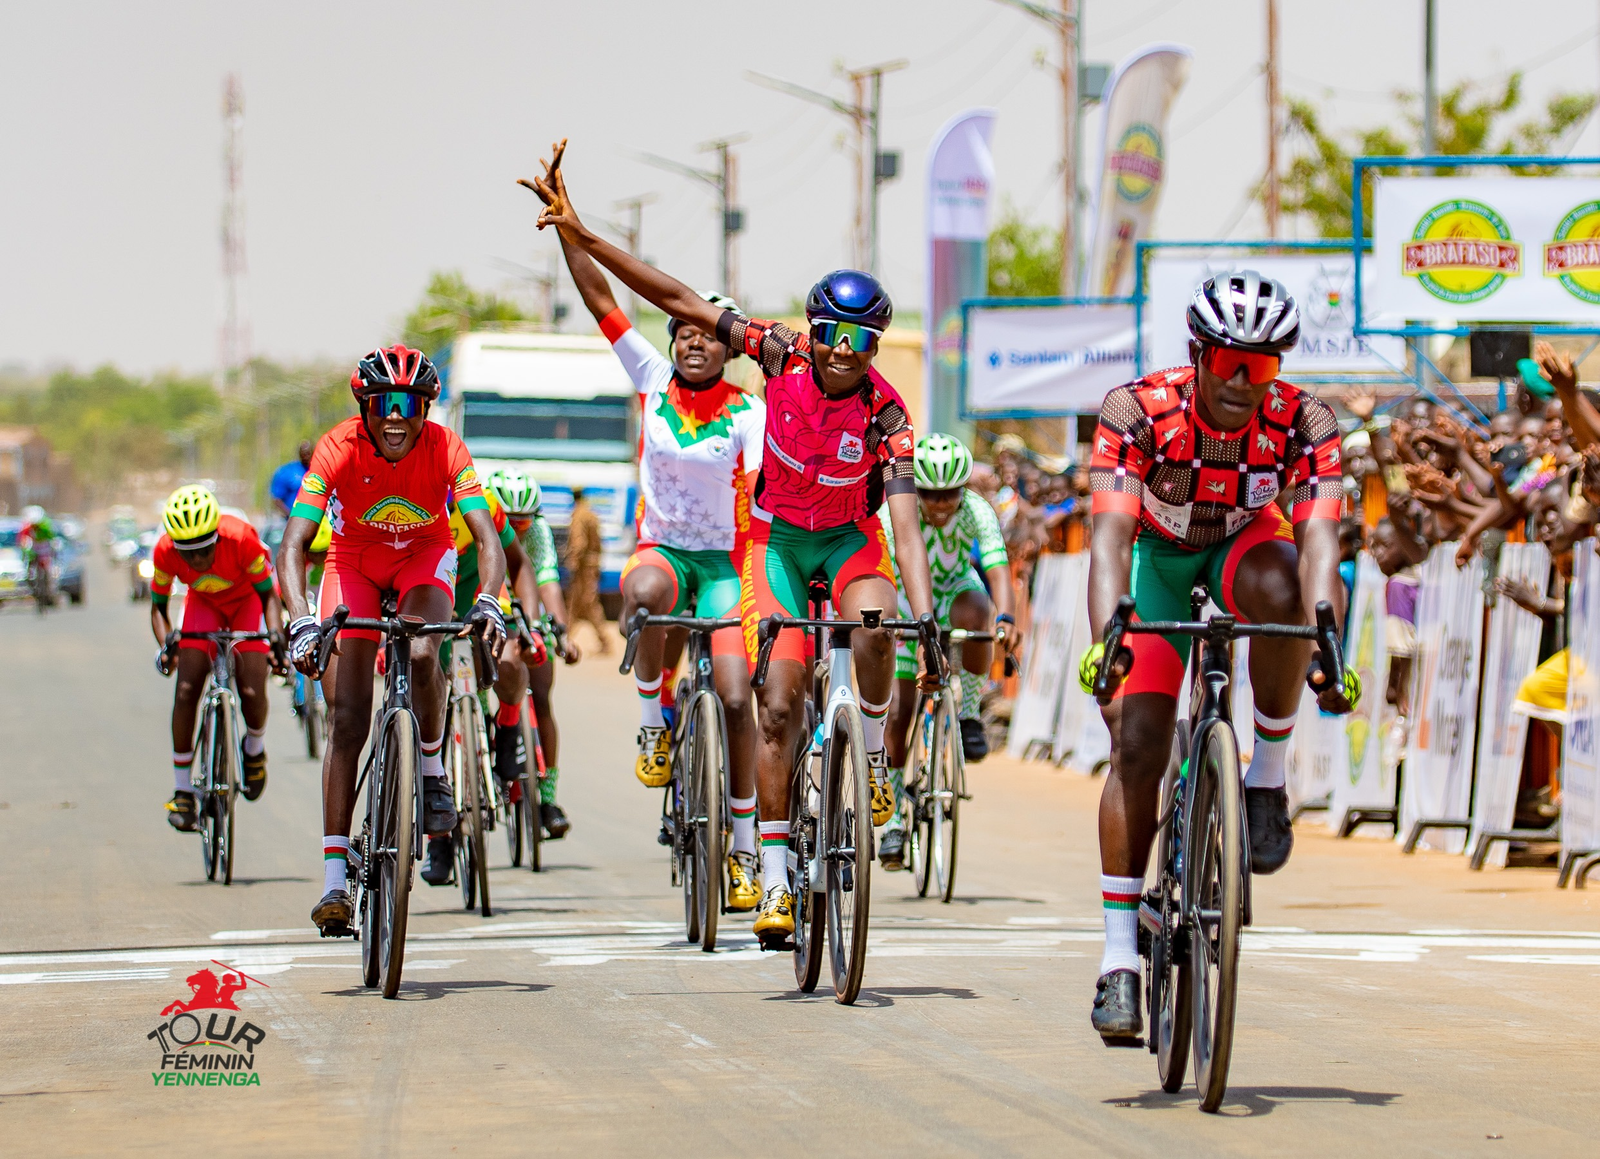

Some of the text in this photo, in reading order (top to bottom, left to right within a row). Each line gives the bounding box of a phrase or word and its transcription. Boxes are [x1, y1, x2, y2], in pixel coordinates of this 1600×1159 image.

[1422, 240, 1500, 267] BRAFASO
[1300, 335, 1372, 357] MSJE
[1251, 486, 1277, 500] TOUR
[741, 611, 761, 664] FASO
